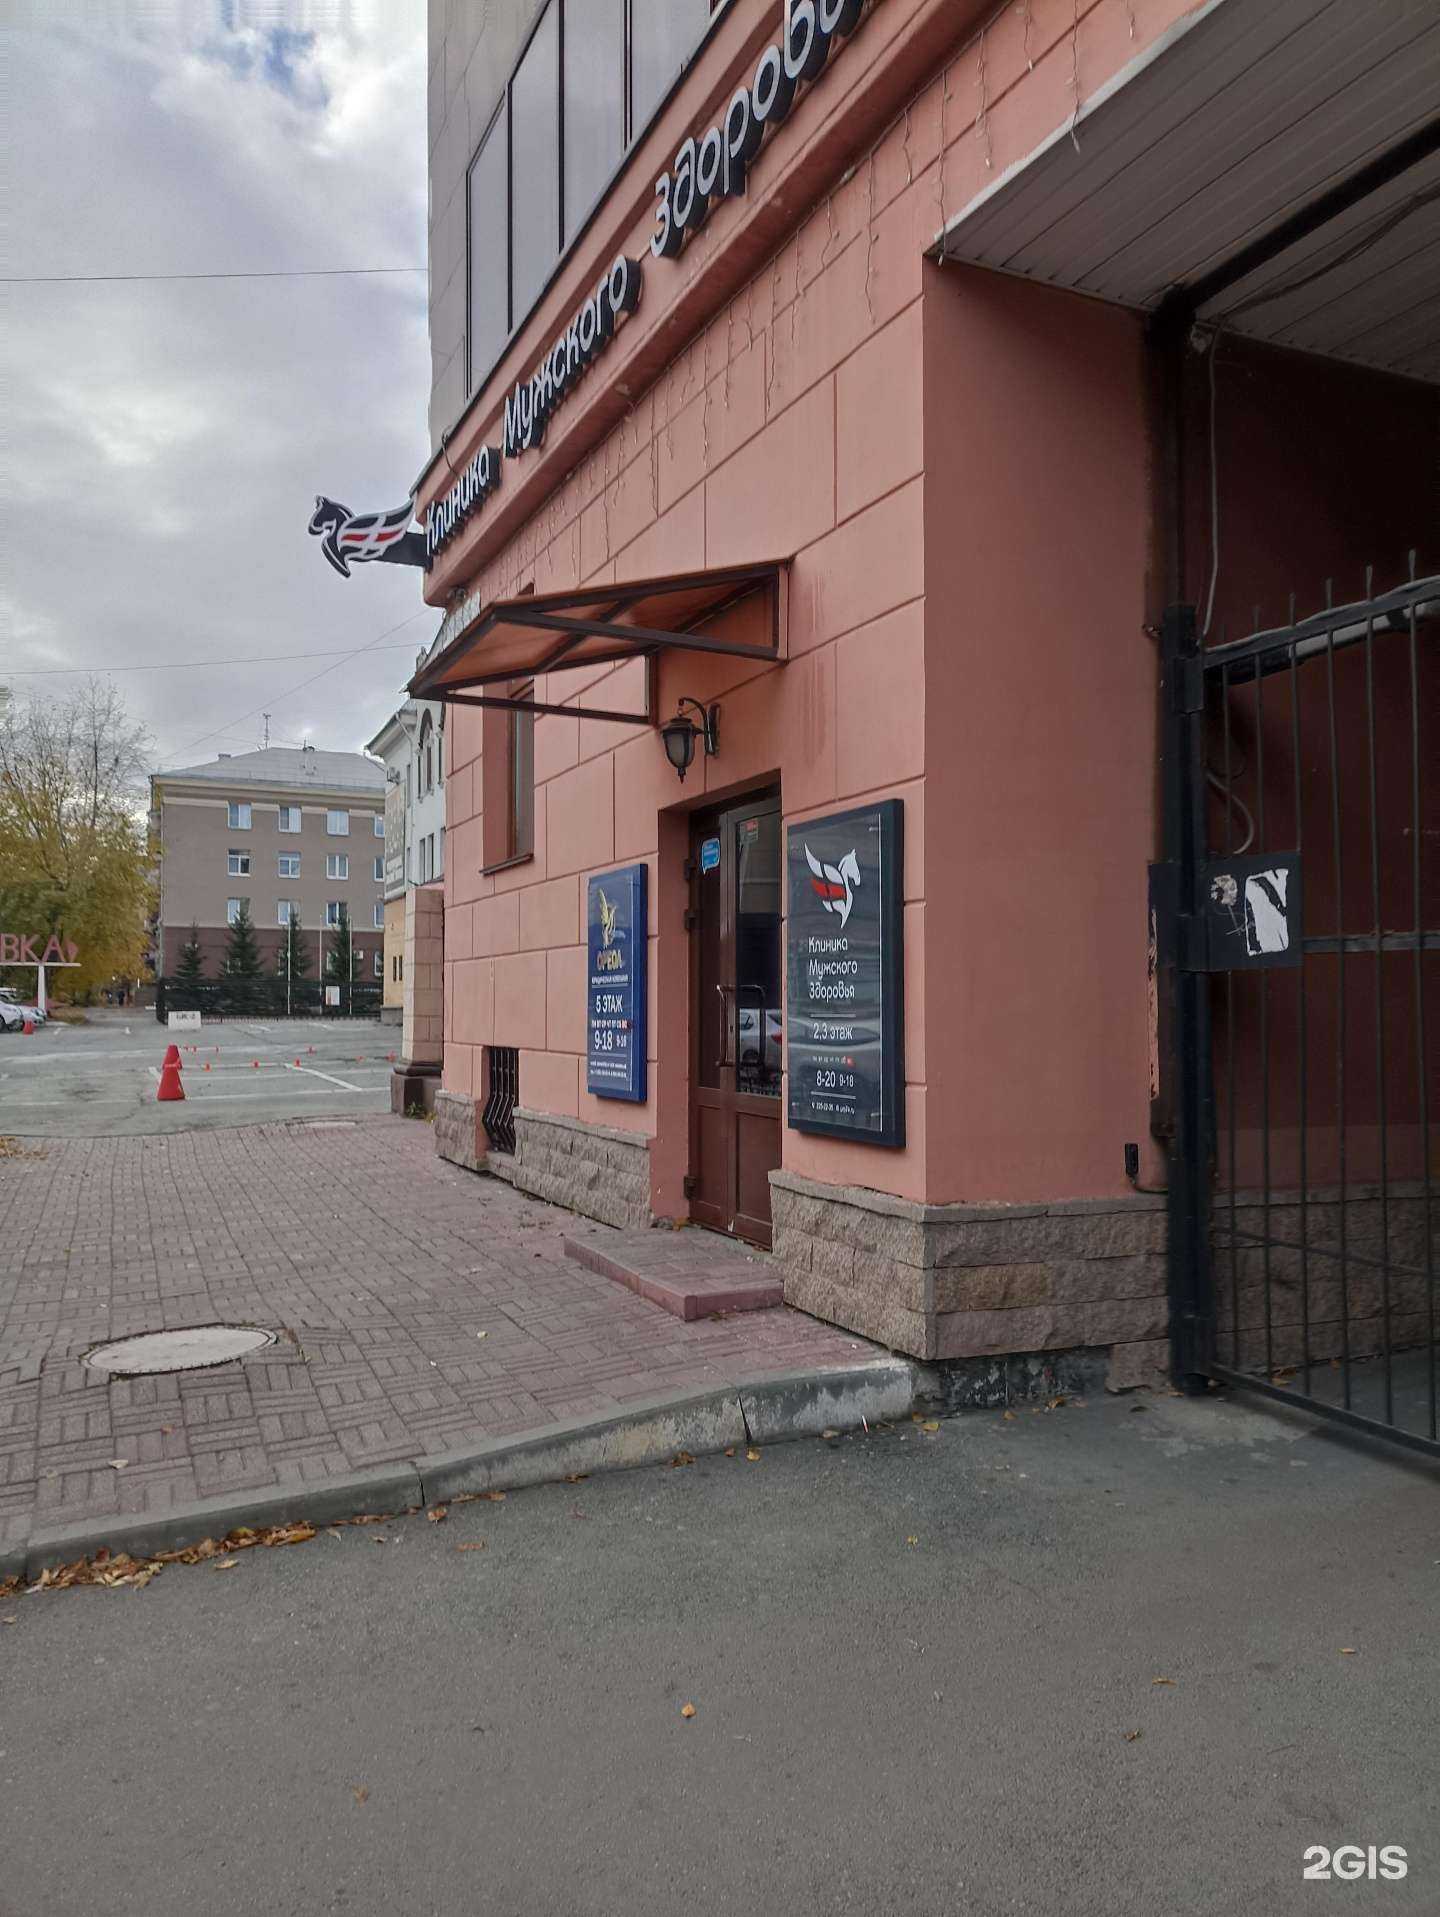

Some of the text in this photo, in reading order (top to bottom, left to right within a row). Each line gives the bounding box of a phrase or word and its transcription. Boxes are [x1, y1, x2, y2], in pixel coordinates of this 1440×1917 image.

[425, 443, 490, 557] Клиника
[503, 254, 628, 456] Мужского
[808, 936, 848, 953] Клиника
[809, 958, 858, 981] Мужского
[809, 980, 855, 1004] Здоровья
[595, 994, 623, 1013] 5 ЭТАЖ
[594, 1029, 613, 1050] 9-18
[829, 1026, 853, 1041] этаж
[816, 1069, 836, 1088] 8-20
